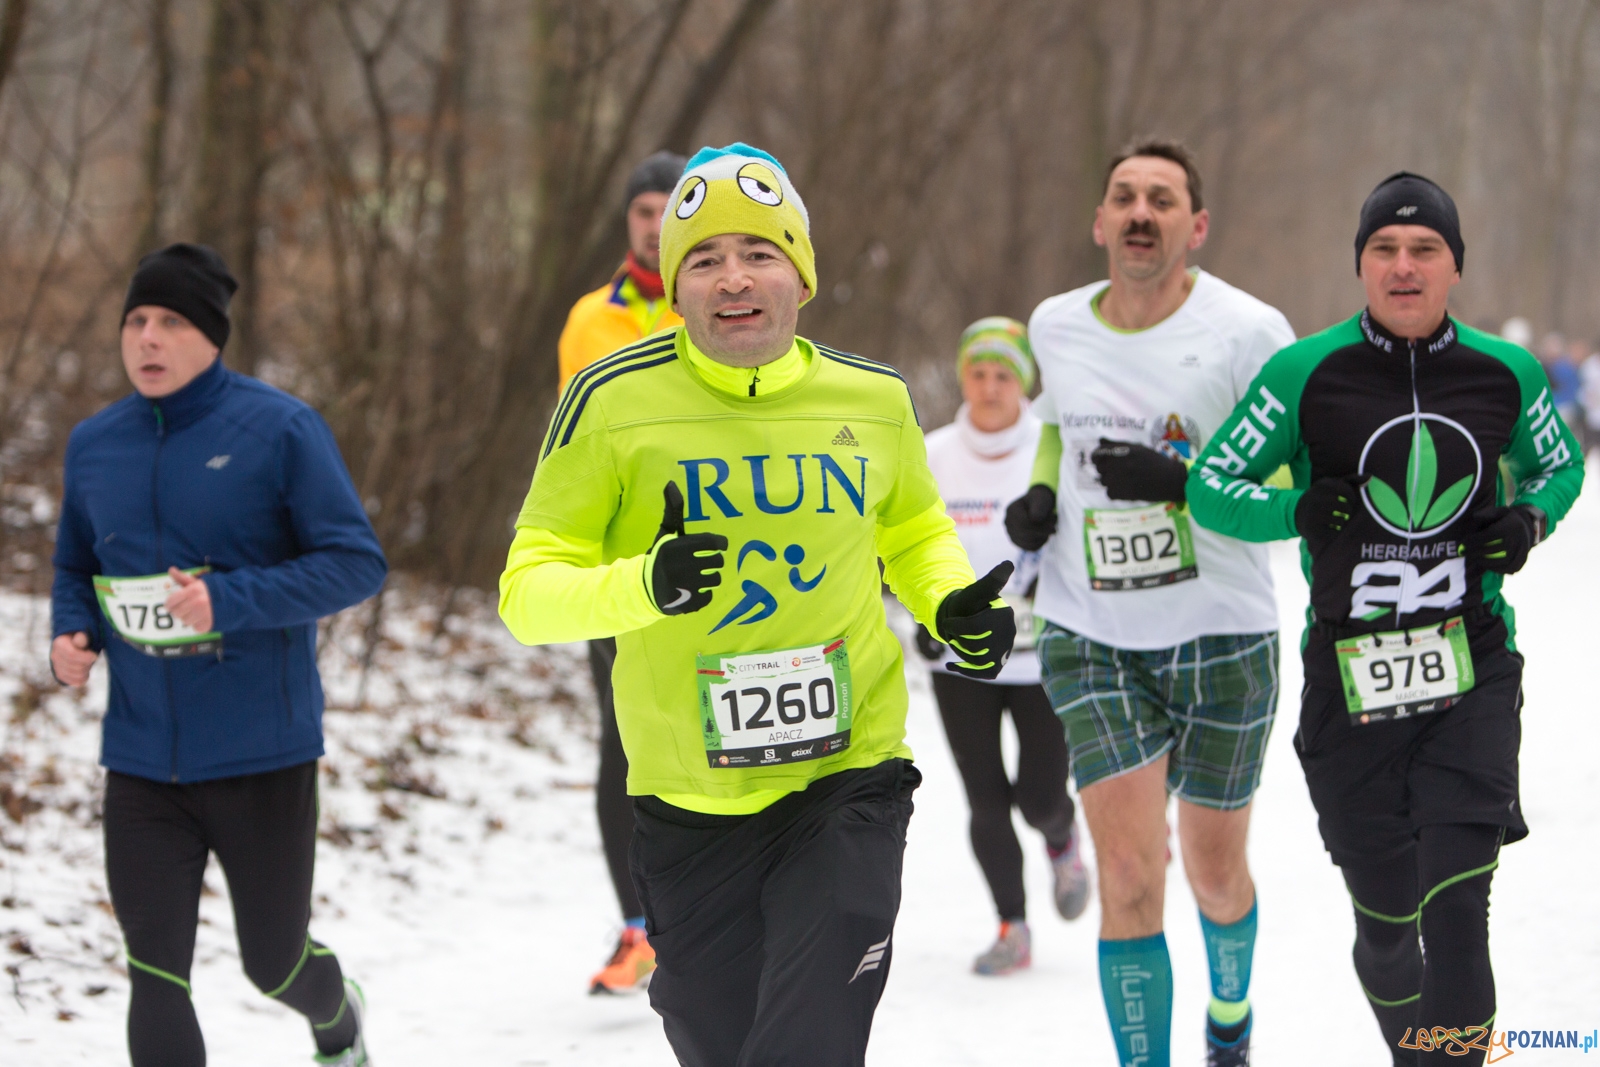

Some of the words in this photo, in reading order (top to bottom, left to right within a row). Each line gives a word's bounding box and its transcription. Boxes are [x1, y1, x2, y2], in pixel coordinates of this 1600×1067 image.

[831, 438, 860, 447] adidas
[677, 453, 869, 522] RUN
[1096, 527, 1178, 564] 1302
[1361, 541, 1456, 560] HERBALIFE
[118, 602, 188, 630] 178
[1369, 650, 1445, 692] 978
[721, 677, 835, 731] 1260
[840, 682, 848, 719] Poznań
[1395, 688, 1429, 702] MARCIN
[768, 729, 803, 743] APACZ
